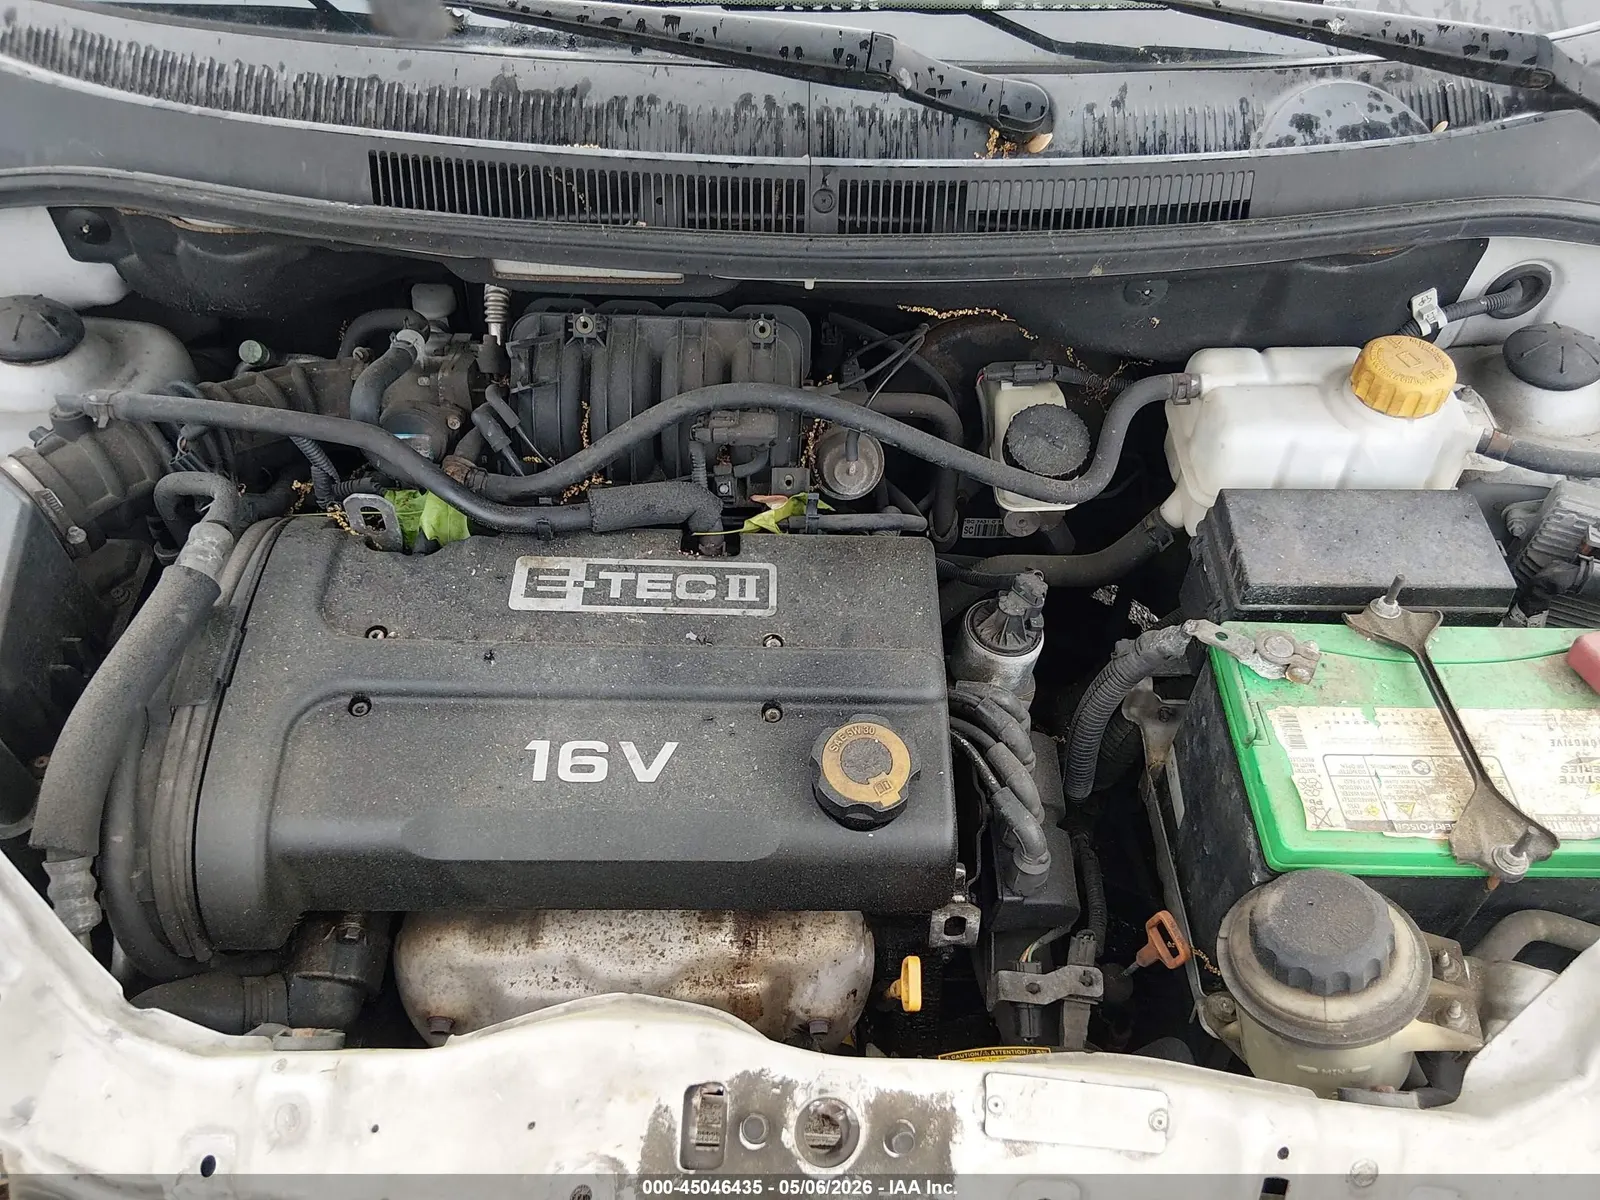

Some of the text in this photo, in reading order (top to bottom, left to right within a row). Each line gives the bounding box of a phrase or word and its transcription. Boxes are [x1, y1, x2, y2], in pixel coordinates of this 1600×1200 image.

[963, 525, 974, 535] SC
[523, 567, 716, 602] E-TEC
[829, 725, 876, 753] SAE 5W 30
